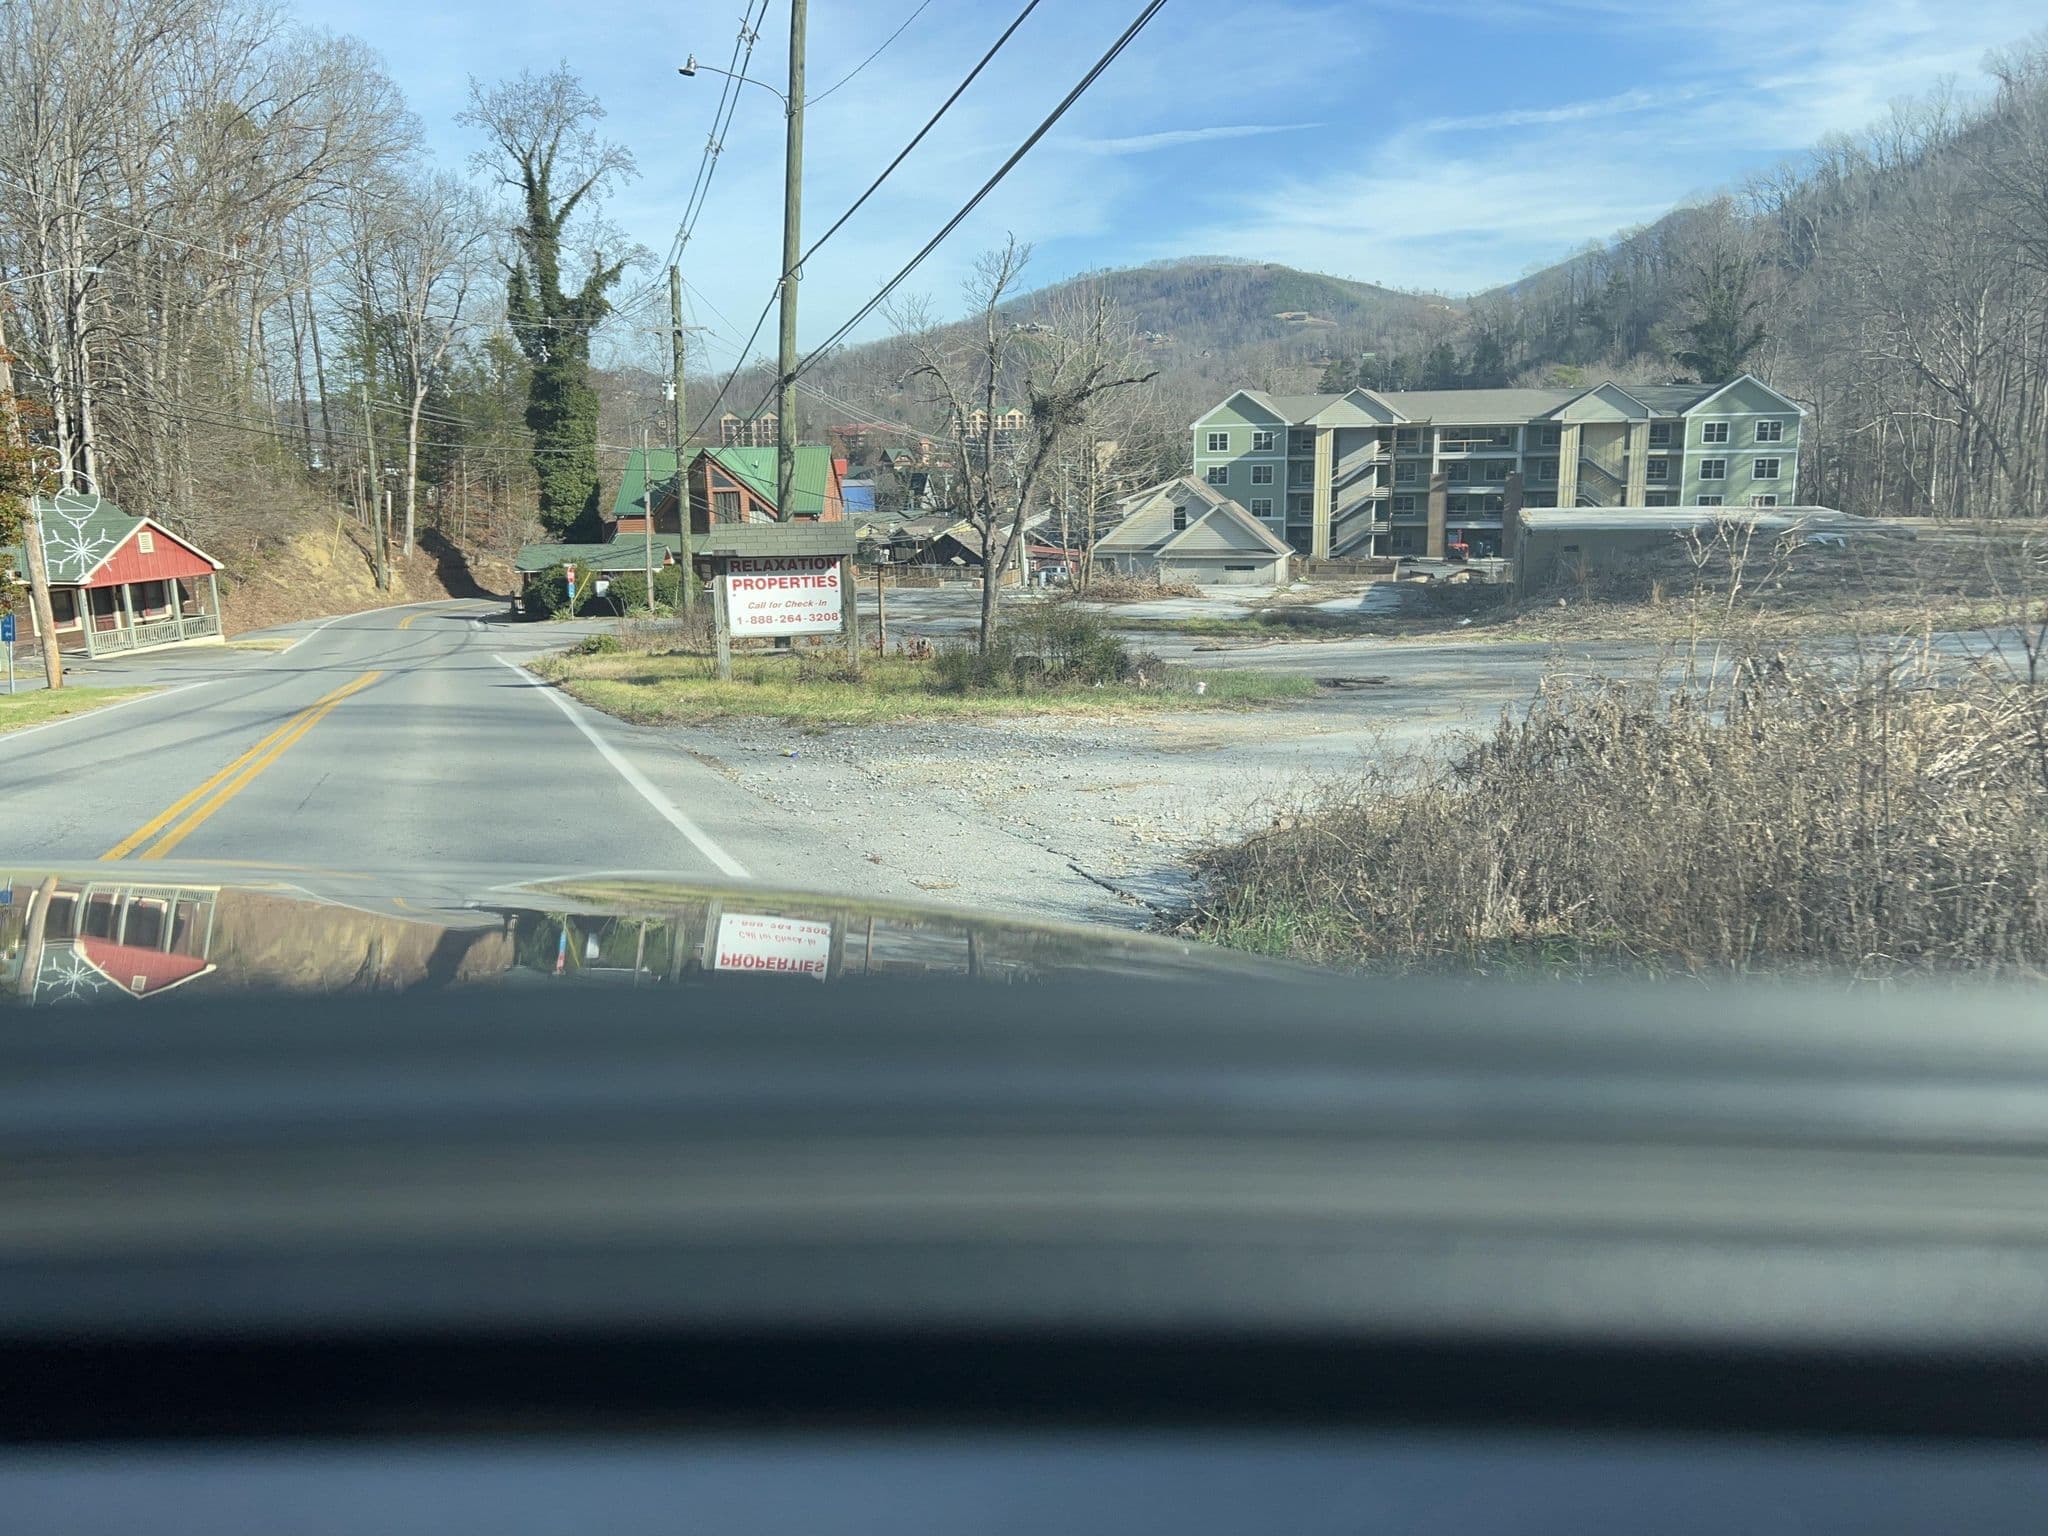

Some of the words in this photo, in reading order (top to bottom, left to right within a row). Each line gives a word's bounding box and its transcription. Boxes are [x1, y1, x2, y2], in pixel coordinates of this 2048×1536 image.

[730, 558, 837, 572] RELAXATION
[732, 575, 838, 591] PROPERTIES
[785, 600, 827, 608] Check-In
[737, 612, 838, 625] 1-888-264-3208
